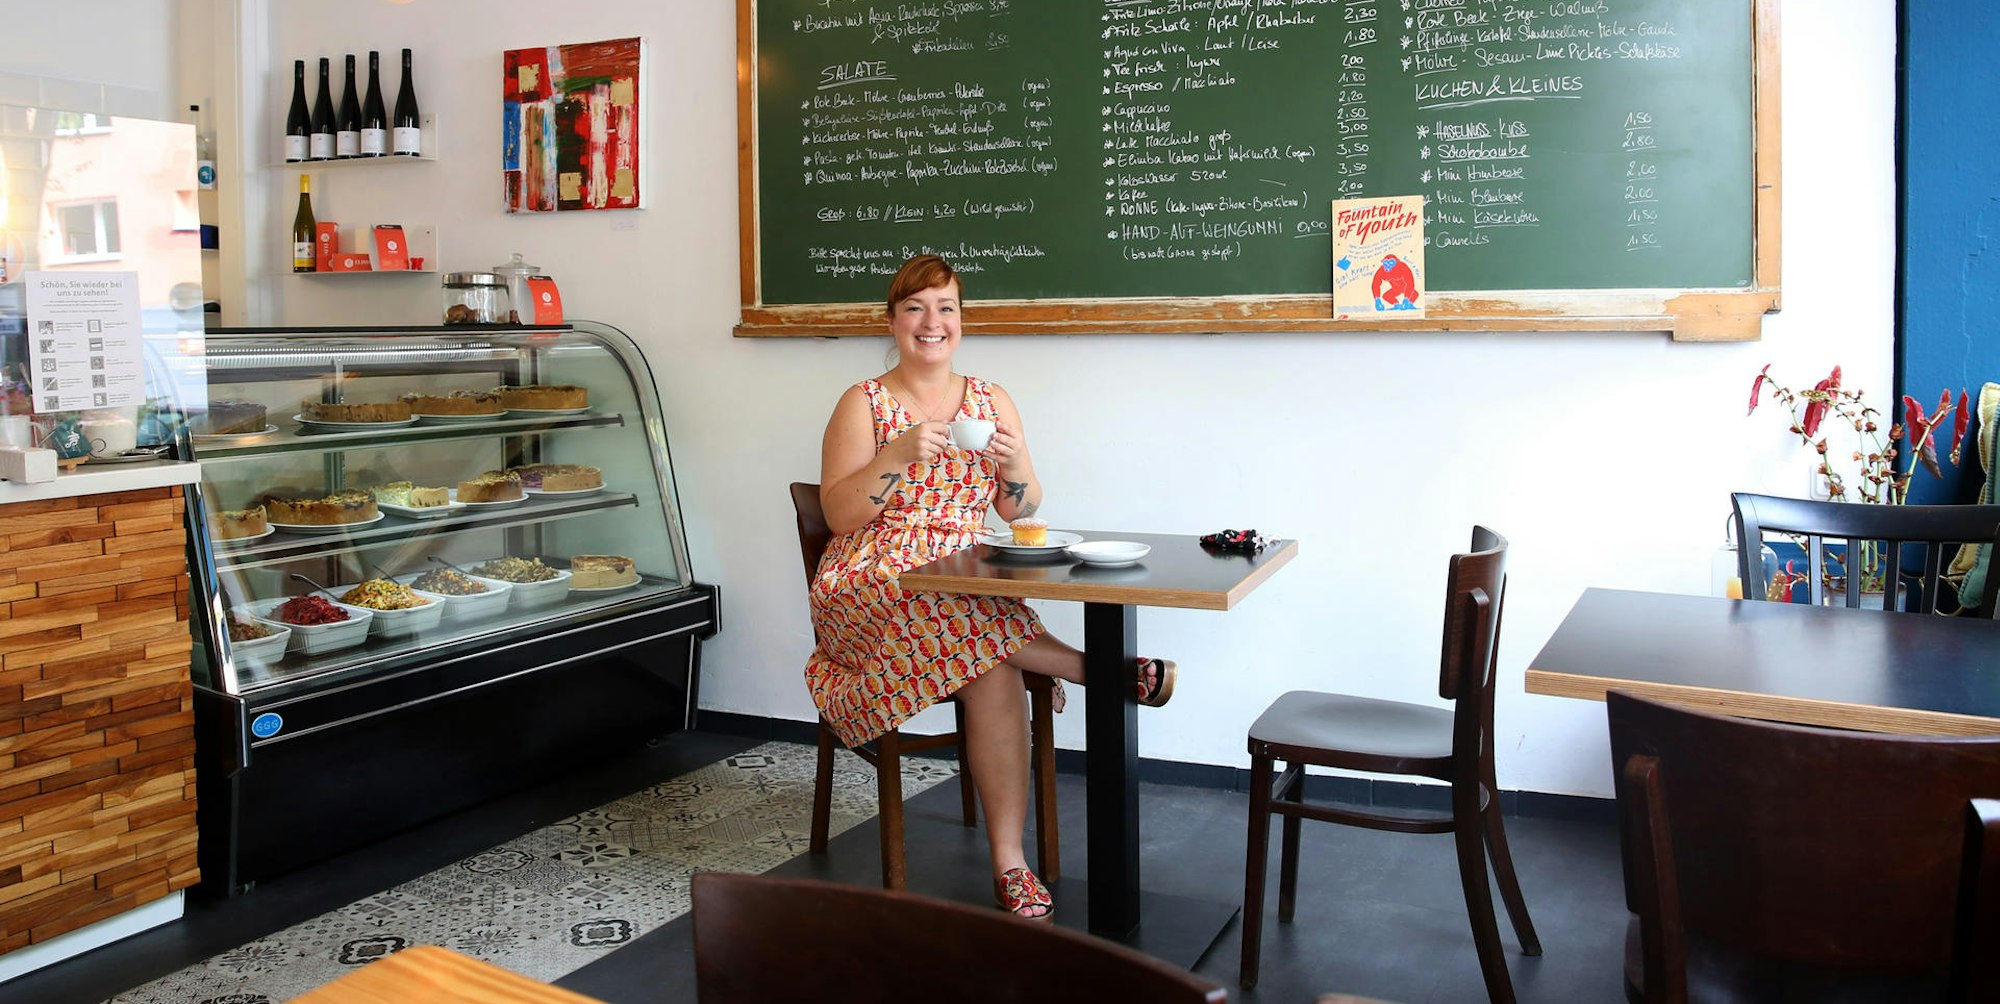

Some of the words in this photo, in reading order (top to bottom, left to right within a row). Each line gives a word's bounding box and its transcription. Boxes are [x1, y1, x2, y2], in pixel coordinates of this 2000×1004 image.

[845, 12, 863, 27] mit
[1344, 8, 1377, 20] 2,30
[1417, 11, 1449, 30] Rote
[1503, 5, 1538, 25] Ziege
[1550, 1, 1608, 20] Walnuß
[1109, 23, 1142, 37] Fritz
[1208, 15, 1239, 33] Apfel
[1256, 11, 1316, 29] Rhabarber
[1344, 28, 1376, 43] 1,80
[1598, 21, 1626, 38] Möhre
[1161, 41, 1185, 54] Viva
[1205, 36, 1235, 51] Laut
[1249, 37, 1280, 51] Leise
[1415, 53, 1458, 71] Möhre
[1474, 48, 1525, 67] Sesam
[1568, 42, 1612, 60] Pickles
[820, 60, 887, 83] SALATE
[1111, 63, 1130, 76] Tee
[1135, 60, 1167, 77] frisch
[1186, 54, 1221, 78] Ingwer
[1338, 72, 1366, 83] 1,80
[864, 89, 889, 102] Möhre
[897, 87, 946, 104] Cranberries
[1114, 81, 1163, 100] Espresso
[1184, 72, 1236, 90] Macchiato
[1339, 90, 1363, 102] 2,20
[1415, 80, 1483, 102] KUCHEN
[1486, 74, 1506, 96] &
[921, 104, 955, 121] Paprika
[1337, 108, 1366, 119] 2,50
[1624, 112, 1652, 127] 1,50
[867, 128, 889, 140] Möhre
[895, 126, 923, 144] Paprika
[1337, 121, 1368, 133] 3,00
[1115, 137, 1139, 150] Latte
[1146, 130, 1200, 148] Macchiato
[1336, 143, 1370, 155] 3,50
[814, 150, 838, 165] Pasta
[865, 147, 899, 160] Tomaten
[1168, 149, 1200, 164] Kakao
[1204, 149, 1223, 161] mit
[1338, 163, 1367, 175] 3,50
[815, 169, 852, 184] Quinoa
[860, 165, 898, 188] Aubergine
[905, 160, 939, 186] Paprika
[1437, 166, 1461, 181] Mini
[1338, 180, 1363, 192] 2,00
[1436, 189, 1465, 204] Mini
[1438, 210, 1465, 224] Mini
[1627, 209, 1658, 222] 1,50
[1297, 221, 1327, 233] 0,00
[863, 251, 881, 259] uns
[40, 280, 68, 289] Schön,
[70, 280, 81, 288] Sie
[82, 280, 108, 288] wieder
[110, 280, 122, 288] bei
[83, 289, 108, 297] sehen!
